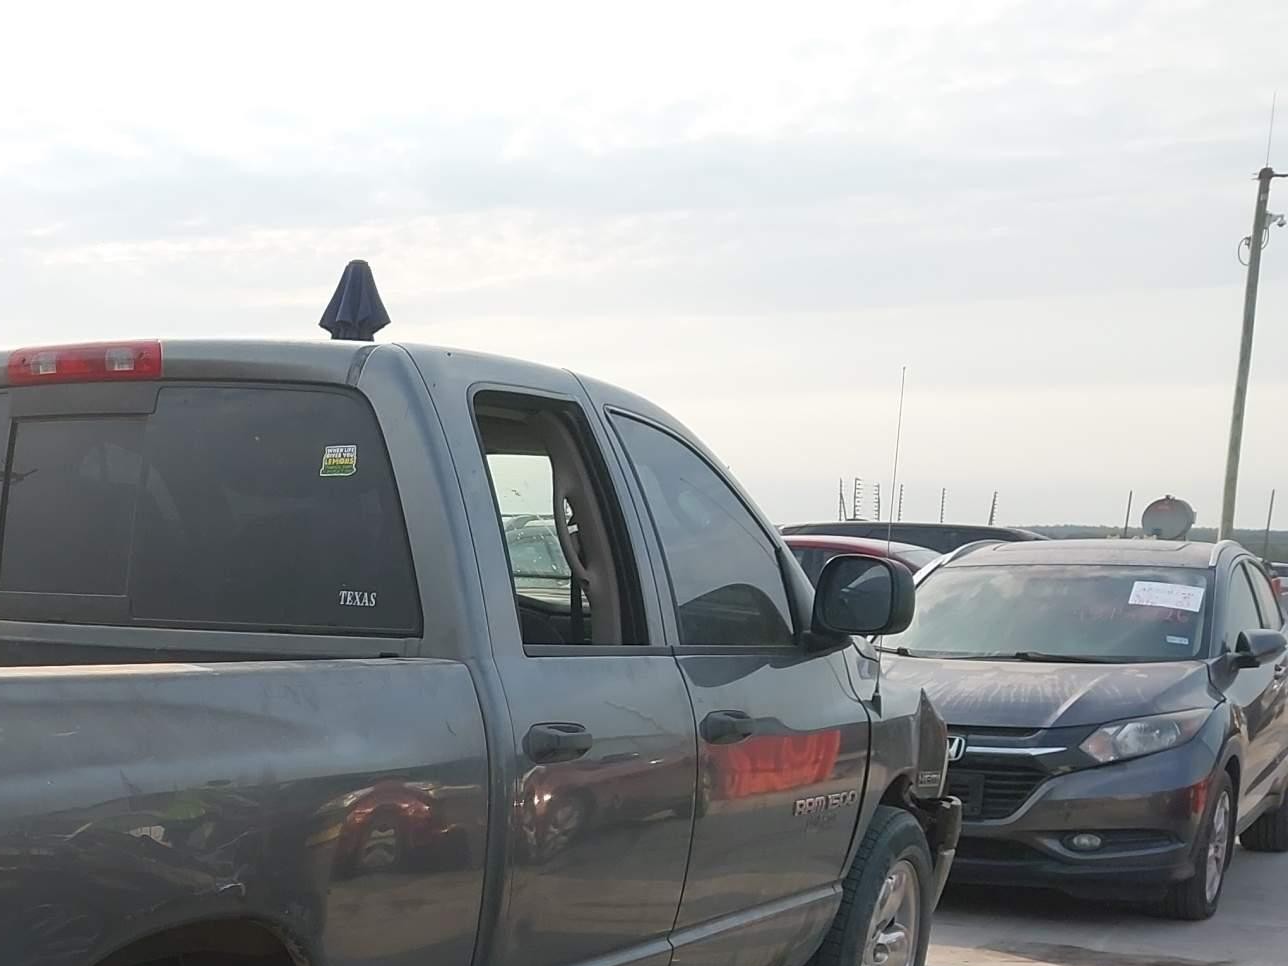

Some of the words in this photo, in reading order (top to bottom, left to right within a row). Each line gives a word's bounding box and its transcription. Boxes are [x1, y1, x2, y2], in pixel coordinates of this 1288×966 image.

[338, 590, 377, 607] TEXAS
[793, 796, 826, 816] RAM
[827, 790, 857, 809] 1500
